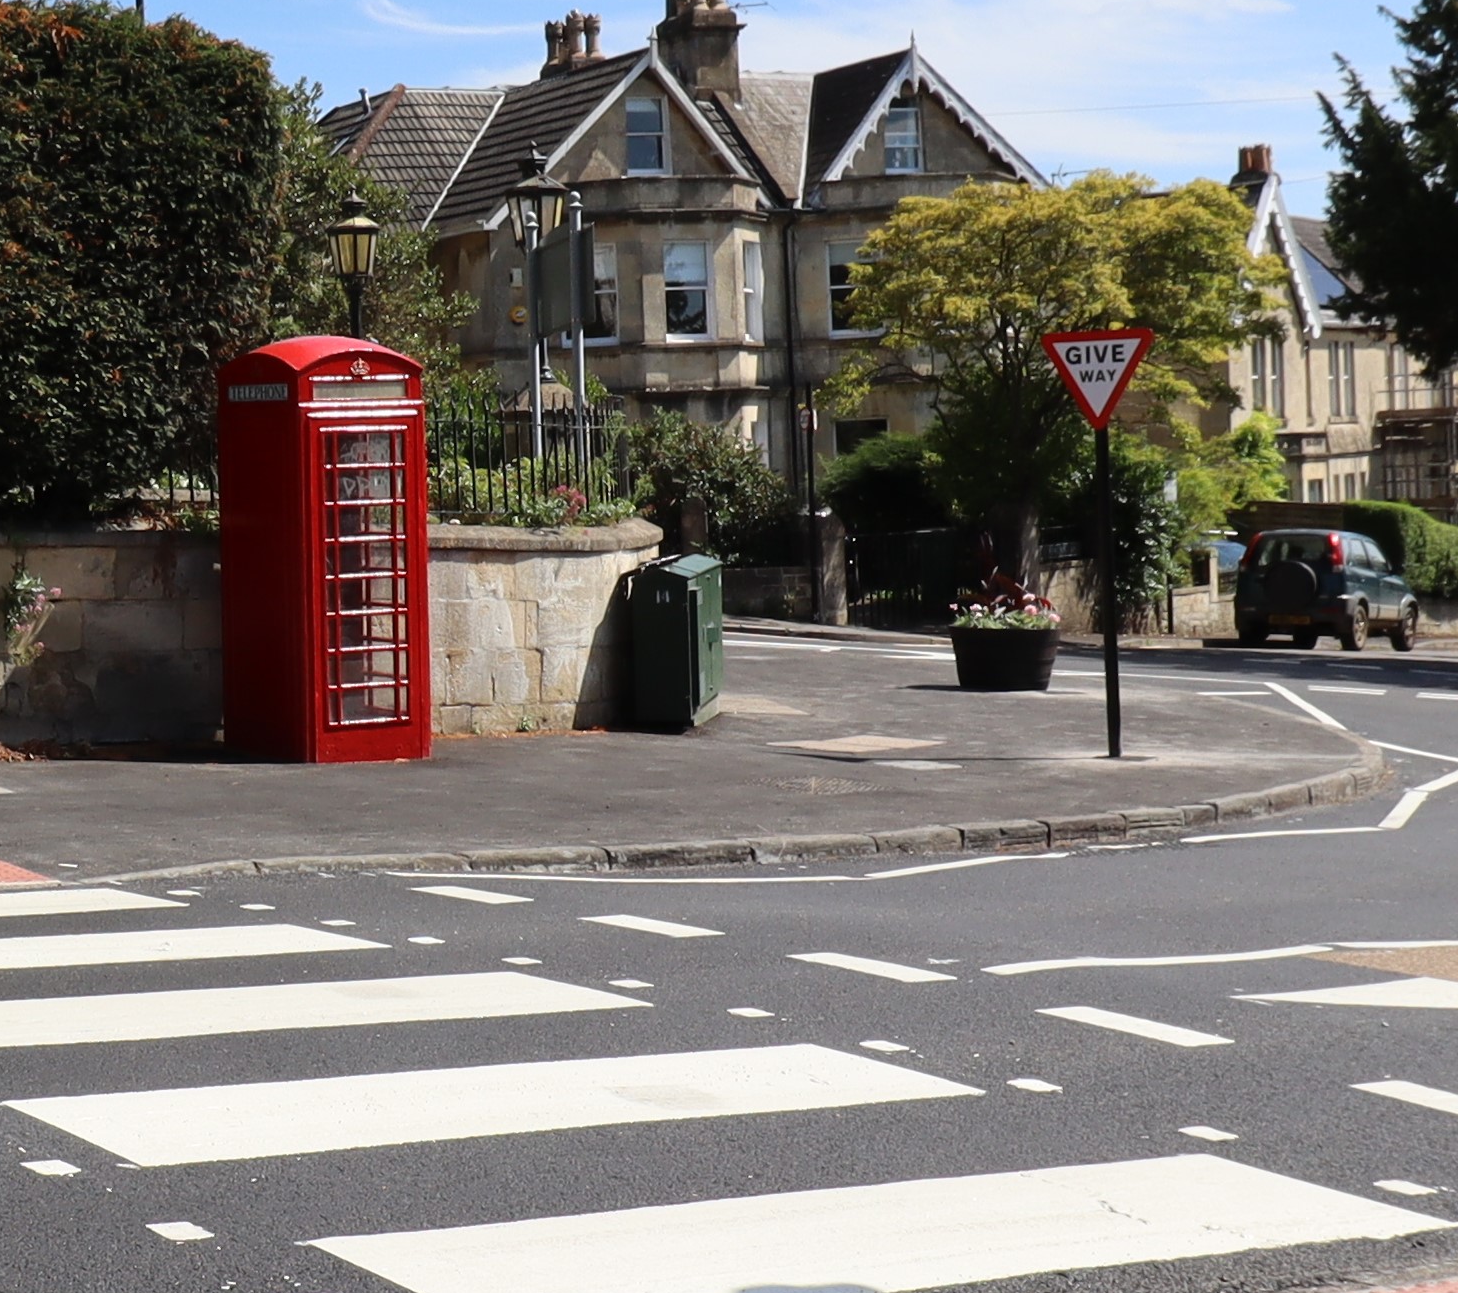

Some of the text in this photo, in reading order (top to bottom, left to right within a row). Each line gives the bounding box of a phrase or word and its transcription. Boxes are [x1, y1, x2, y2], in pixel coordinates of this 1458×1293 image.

[1065, 344, 1125, 365] GIVE
[1079, 369, 1117, 383] WAY
[231, 385, 287, 400] TELEPHONE
